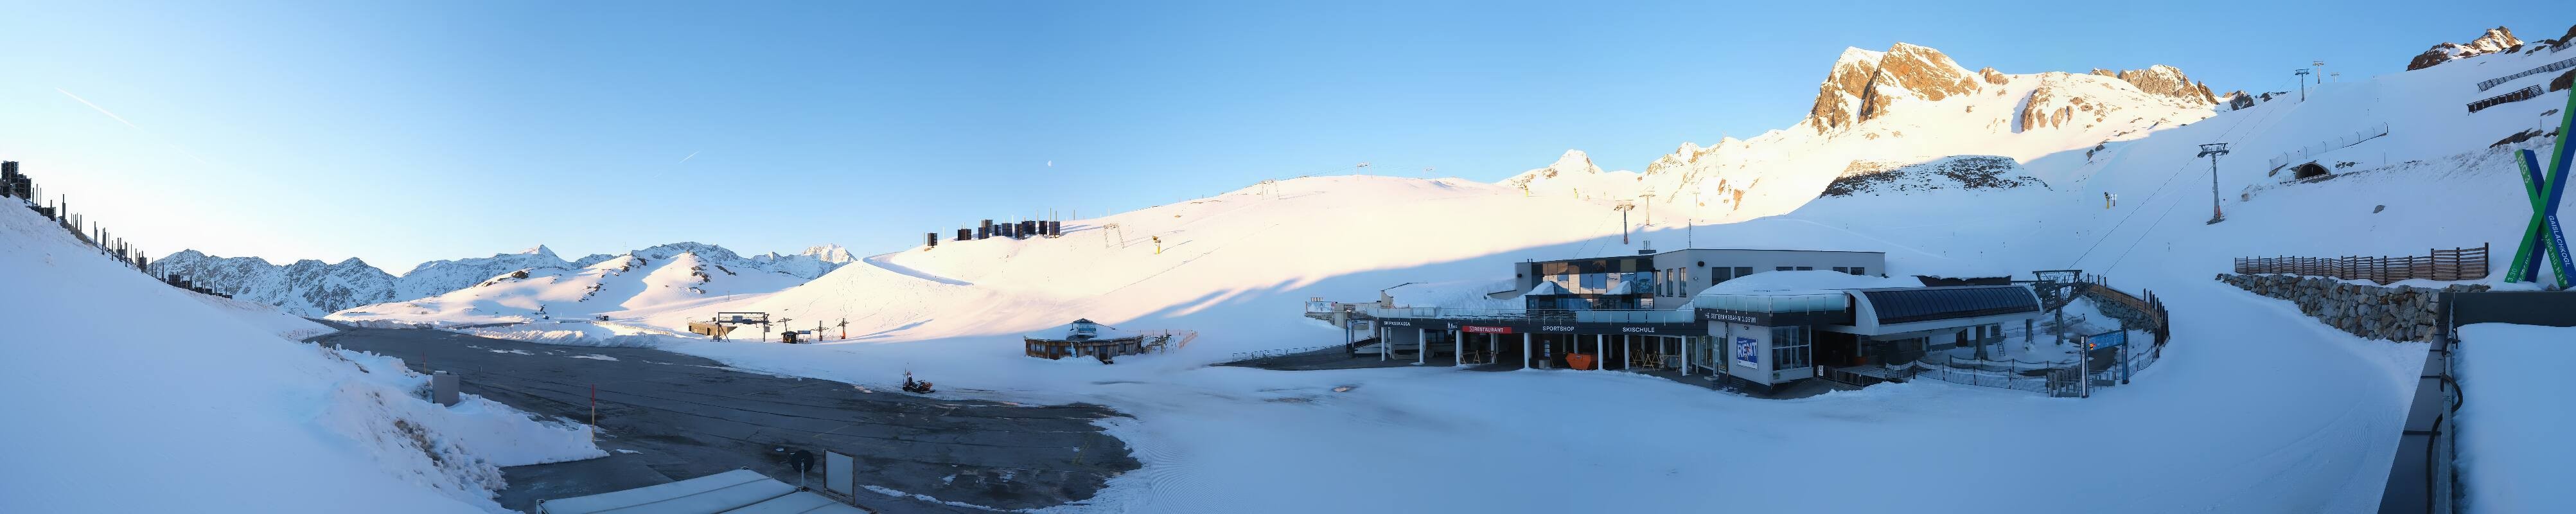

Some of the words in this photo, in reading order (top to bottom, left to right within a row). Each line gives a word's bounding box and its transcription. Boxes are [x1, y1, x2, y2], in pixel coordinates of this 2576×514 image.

[2518, 154, 2527, 175] BIG
[2525, 175, 2530, 183] 3
[2549, 215, 2570, 267] GAISLACHKOGL
[1737, 342, 1757, 358] RENT
